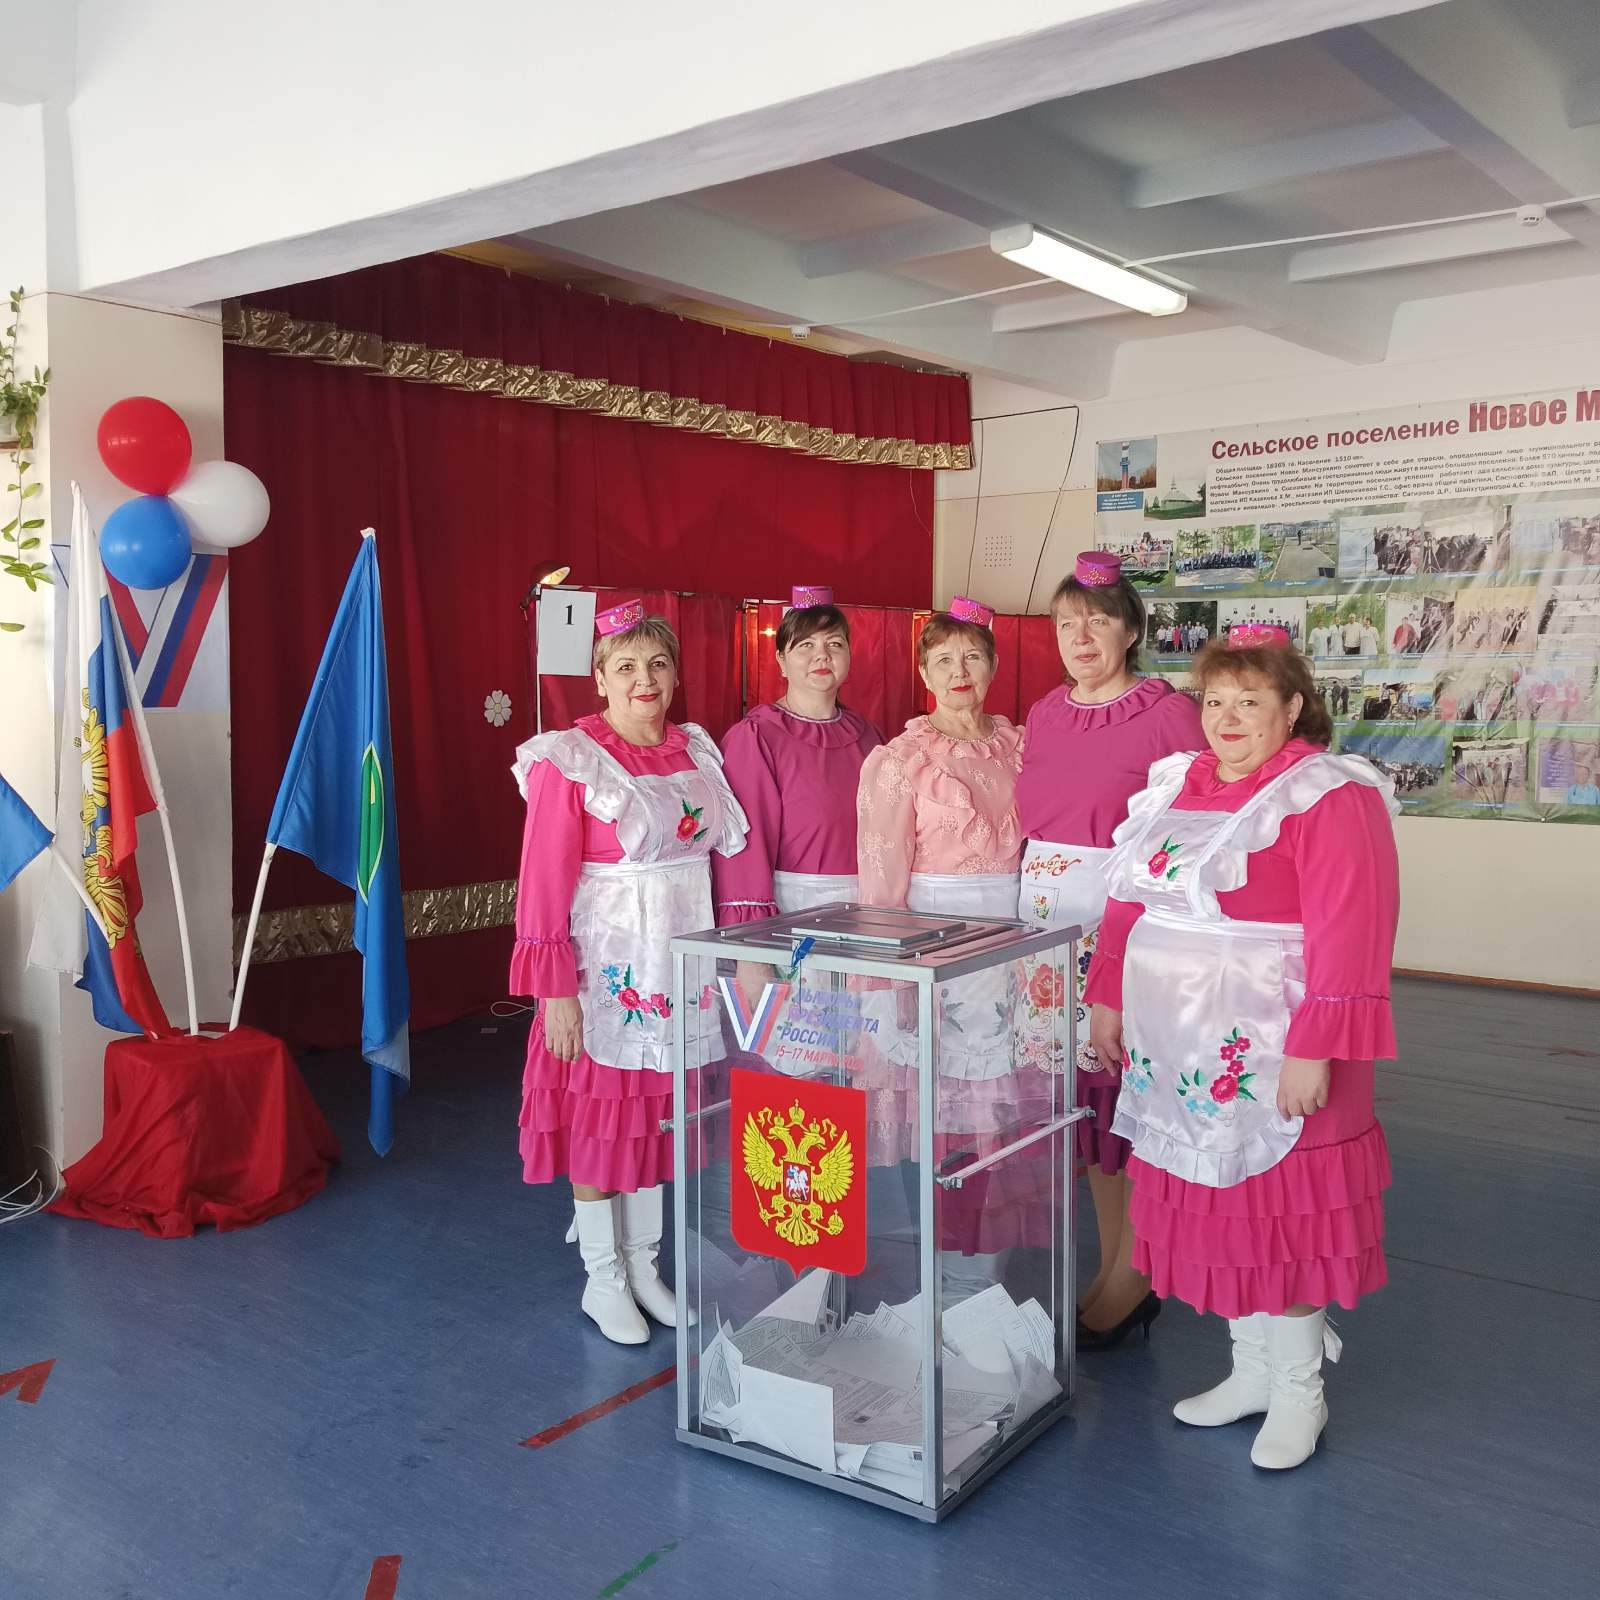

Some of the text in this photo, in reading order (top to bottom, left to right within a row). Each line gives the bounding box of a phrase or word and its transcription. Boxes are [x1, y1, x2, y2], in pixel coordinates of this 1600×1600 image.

[1212, 435, 1319, 459] Сельское
[1327, 419, 1461, 448] поселение
[1469, 399, 1567, 433] Новое
[565, 604, 574, 625] 1
